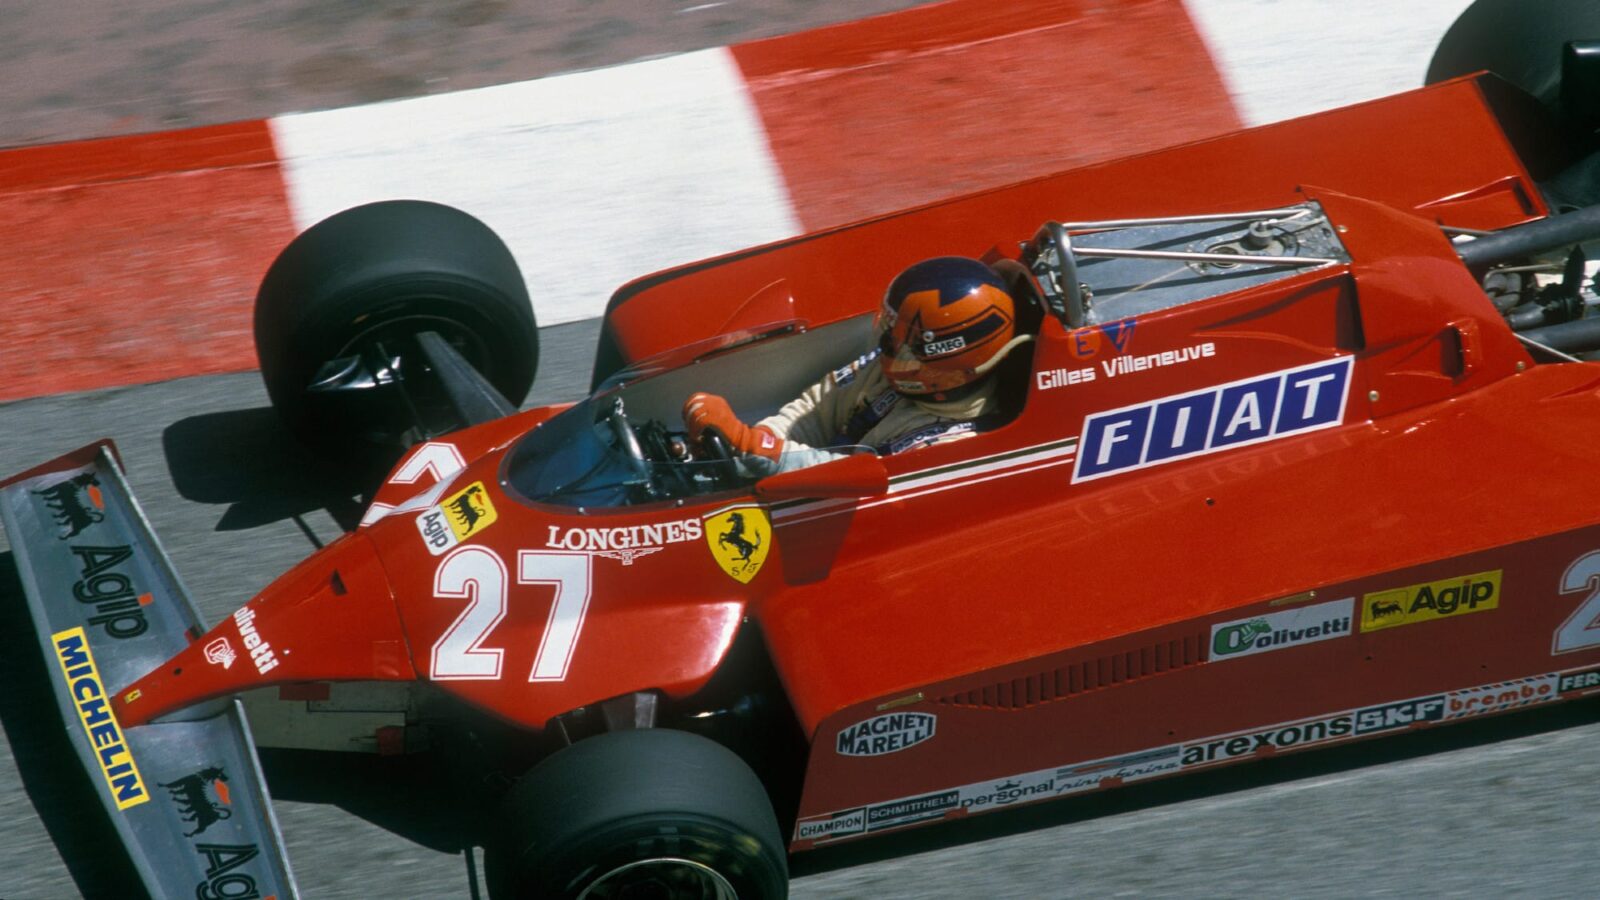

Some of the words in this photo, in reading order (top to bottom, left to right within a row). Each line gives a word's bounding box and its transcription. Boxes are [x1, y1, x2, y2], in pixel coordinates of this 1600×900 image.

[926, 340, 966, 355] SMEG
[1036, 366, 1097, 390] Gilles
[1101, 342, 1216, 378] Villeneuve
[1095, 373, 1336, 465] FIAT
[422, 510, 450, 549] Agip
[545, 517, 703, 550] LONGINES
[70, 543, 153, 639] Agip
[1408, 579, 1495, 615] Agip
[429, 543, 593, 682] 27
[233, 605, 279, 675] olivetti
[1255, 616, 1350, 649] olivetti
[1561, 672, 1600, 690] FER
[57, 635, 144, 803] MICHELIN
[838, 714, 934, 745] MAGNETI
[1357, 700, 1444, 731] SKF
[838, 722, 934, 755] MARELLI
[1181, 714, 1353, 766] arexons
[870, 794, 957, 819] SCHMITTHELM
[960, 778, 1054, 808] personal
[800, 815, 862, 837] CHAMPION
[195, 843, 262, 900] Ag
